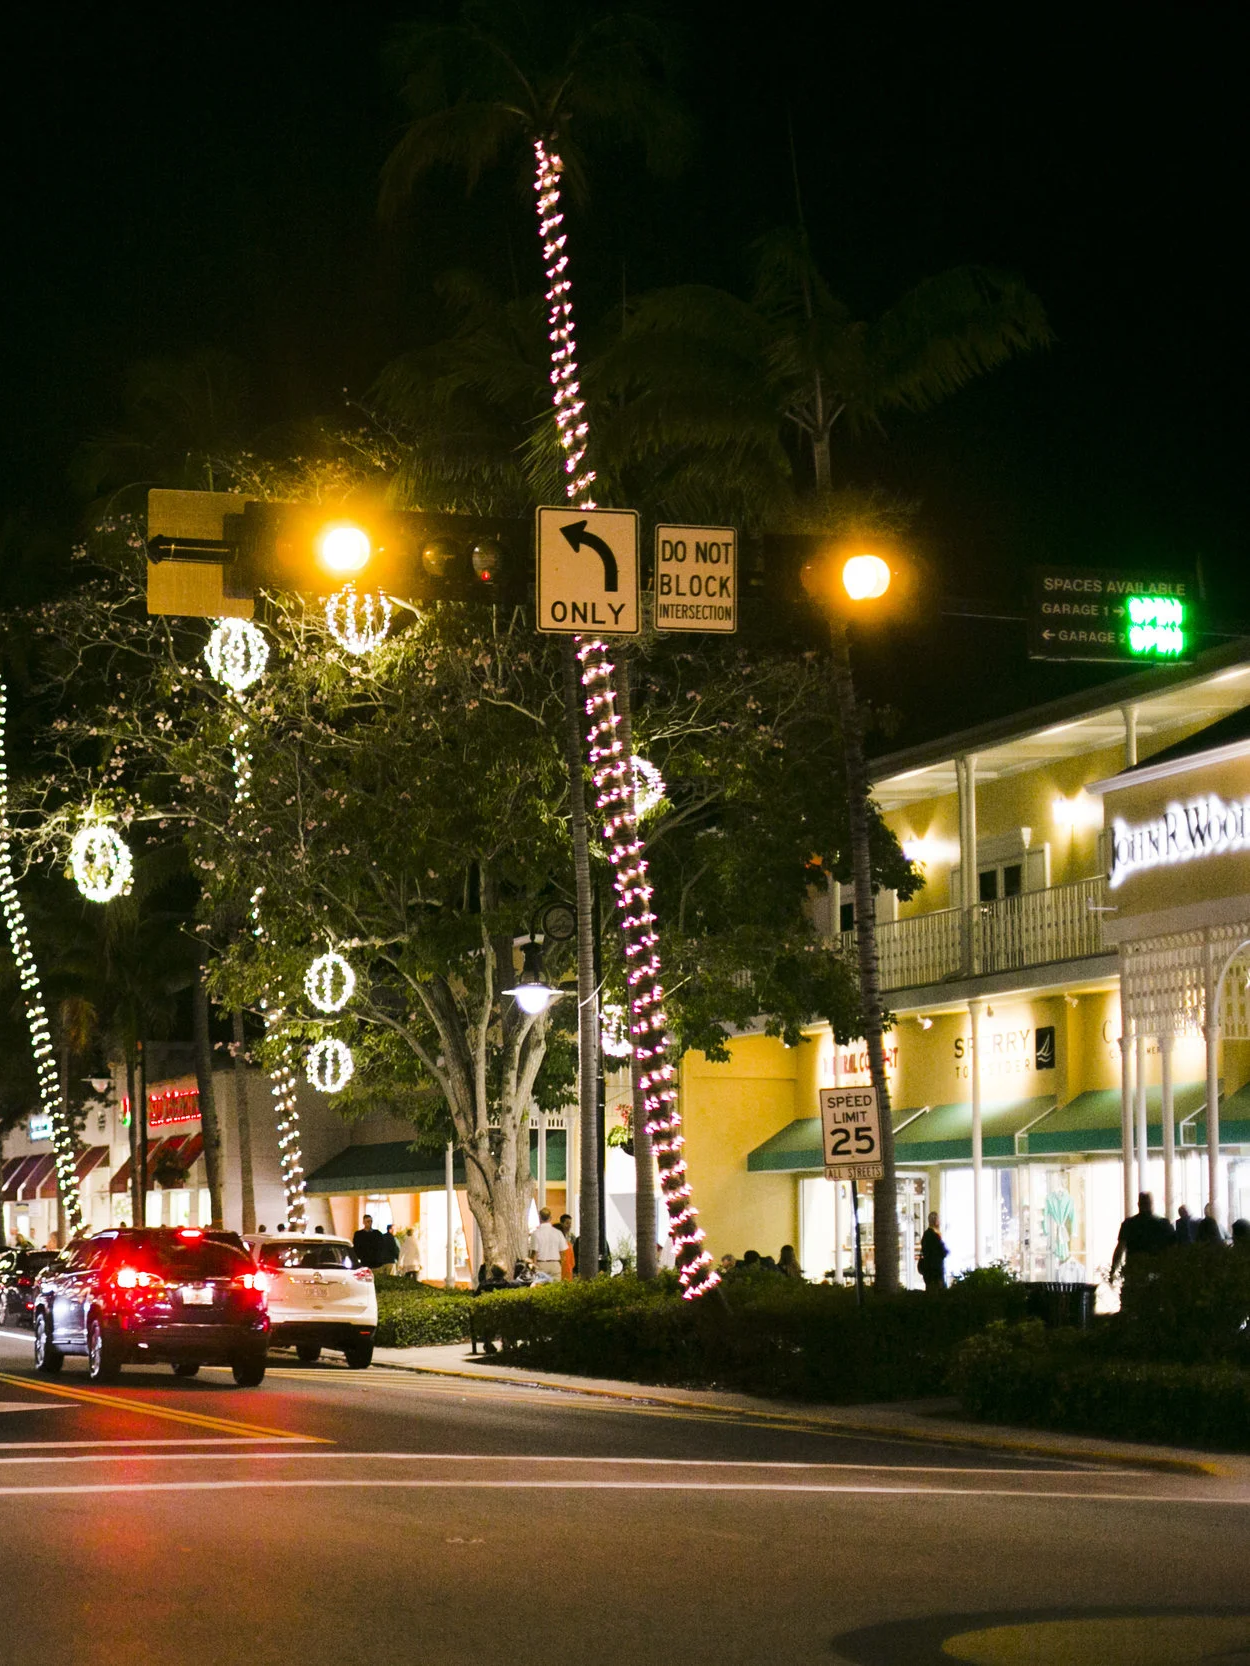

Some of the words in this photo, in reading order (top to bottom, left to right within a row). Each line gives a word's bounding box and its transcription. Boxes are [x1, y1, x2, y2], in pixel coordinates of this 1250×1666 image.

[661, 540, 687, 563] DO
[695, 541, 733, 565] NOT
[660, 573, 732, 598] BLOCK
[1043, 578, 1102, 593] SPACES
[1106, 580, 1186, 597] AVAILABLE
[550, 600, 626, 625] ONLY
[659, 603, 732, 621] INTERSECTION
[1041, 602, 1099, 617] GARAGE
[1058, 629, 1116, 644] GARAGE
[1118, 632, 1127, 644] 2
[954, 1028, 1031, 1059] SPRRY
[827, 1094, 873, 1108] SPEED
[833, 1110, 868, 1124] LIMIT
[830, 1126, 875, 1156] 25
[828, 1168, 843, 1179] ALL
[847, 1166, 881, 1178] STREETS
